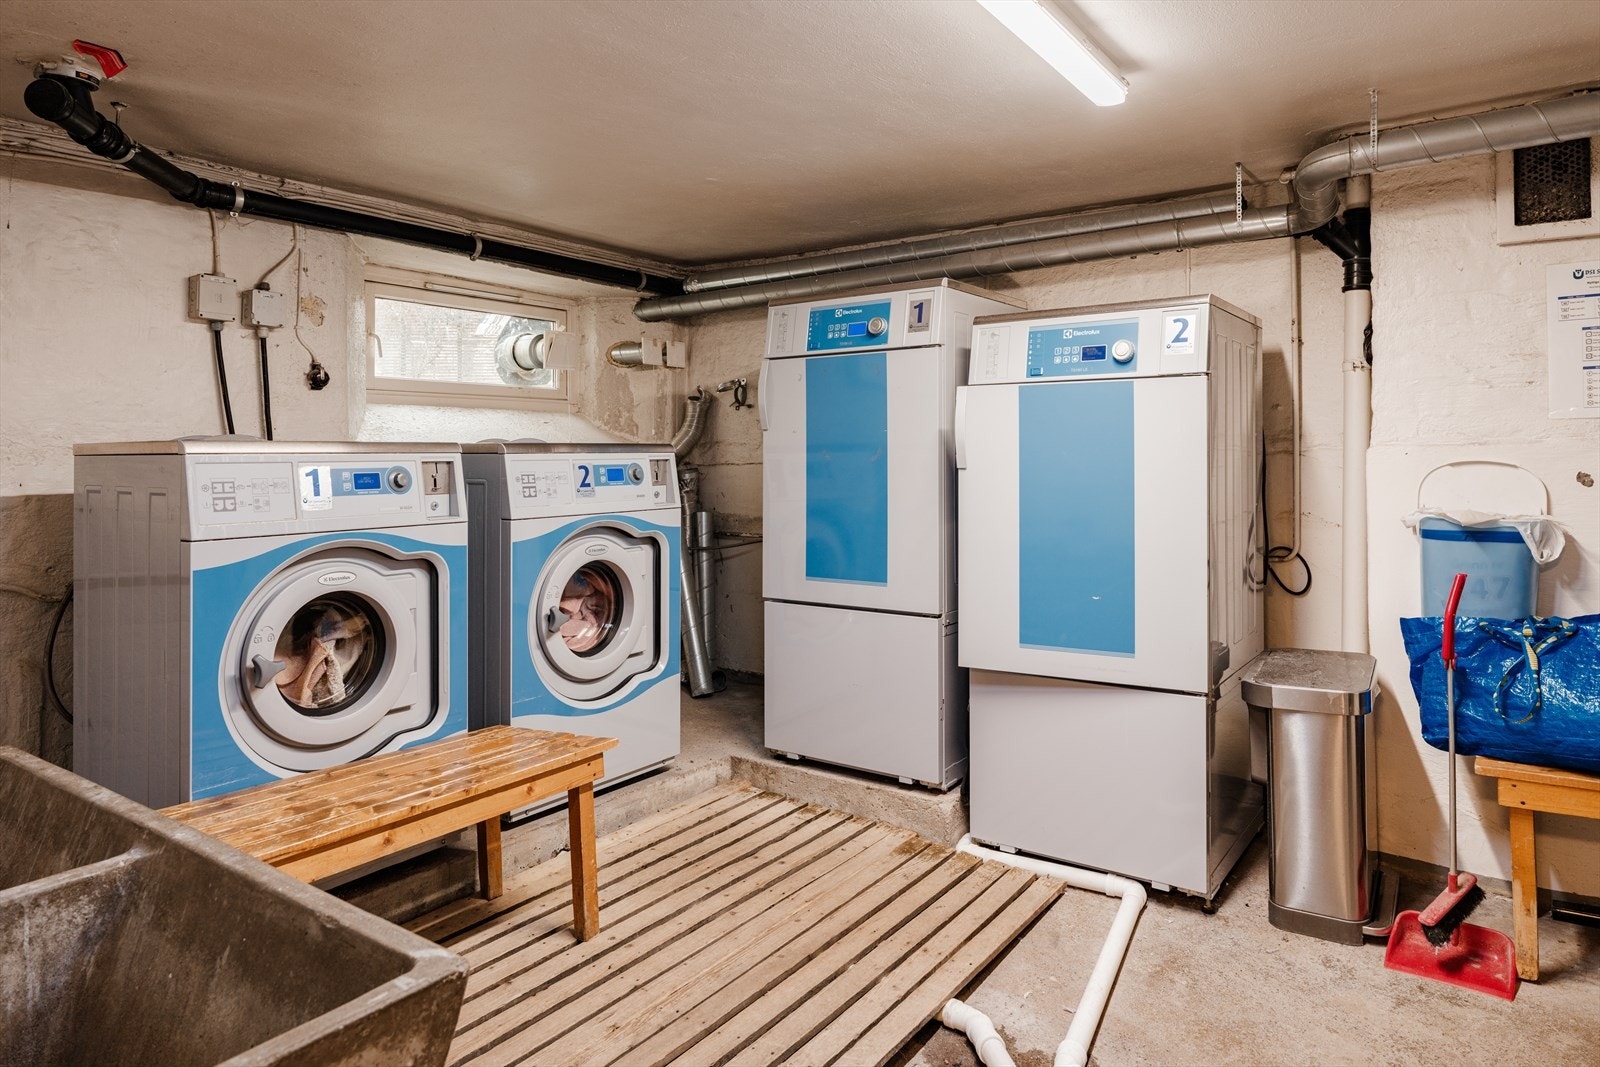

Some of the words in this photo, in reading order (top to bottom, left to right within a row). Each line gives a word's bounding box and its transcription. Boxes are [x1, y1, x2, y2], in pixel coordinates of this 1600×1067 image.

[842, 308, 863, 316] Electrolux
[913, 301, 924, 324] 1
[1073, 329, 1100, 337] Electrolux
[1170, 317, 1190, 344] 2
[305, 468, 321, 497] 1
[577, 465, 592, 488] 2
[1470, 576, 1511, 599] 47
